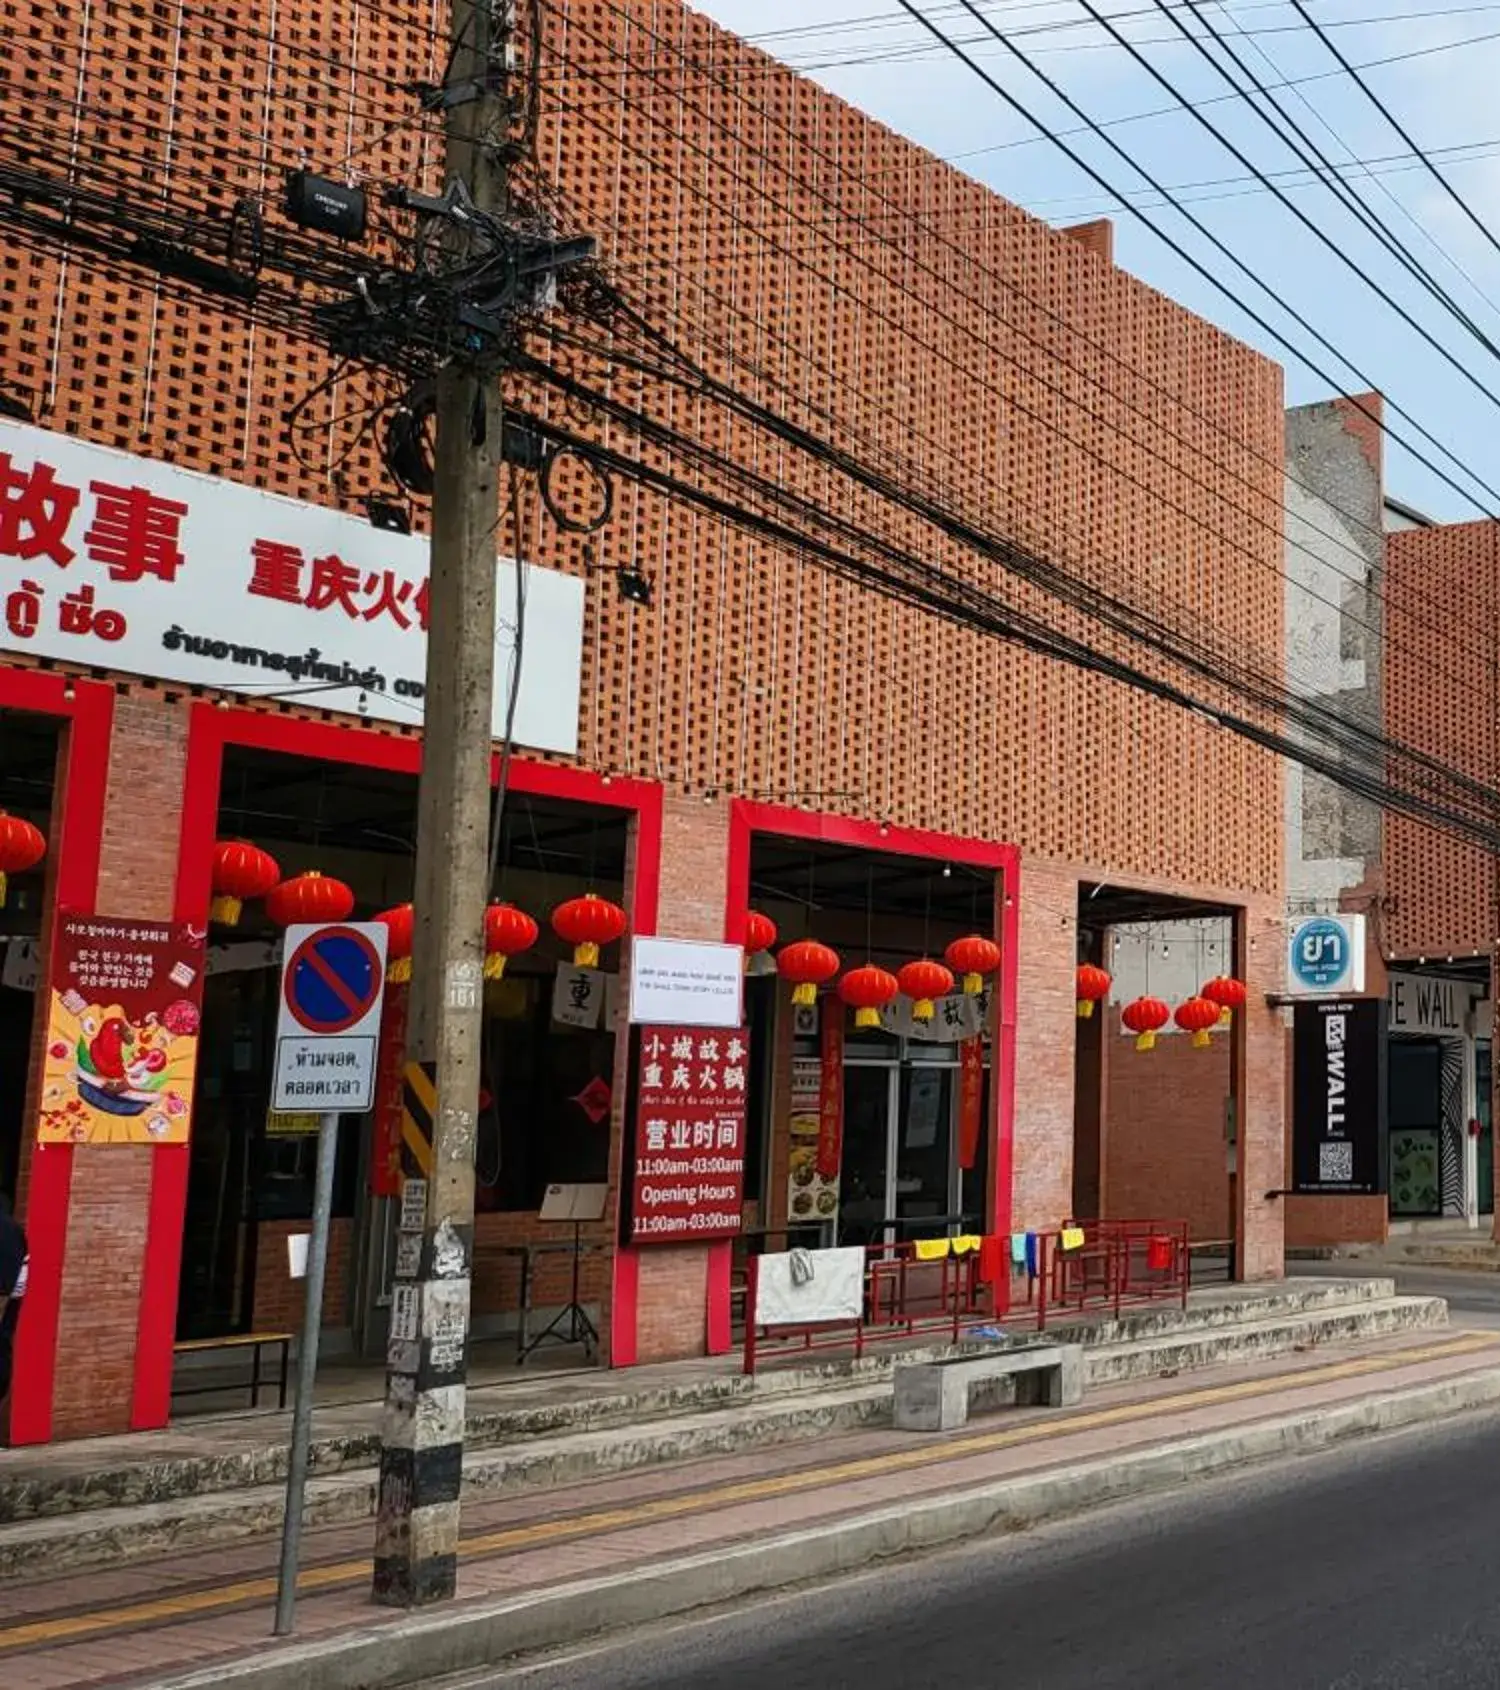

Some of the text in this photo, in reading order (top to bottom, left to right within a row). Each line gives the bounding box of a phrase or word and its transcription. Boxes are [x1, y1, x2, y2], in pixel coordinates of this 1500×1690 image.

[248, 539, 430, 632] 重庆火
[1303, 935, 1341, 963] ยา
[1416, 980, 1459, 1029] WALL
[295, 1047, 358, 1068] ห้ามจอด
[644, 1033, 747, 1063] 小城故事
[285, 1079, 361, 1096] ตลอดเวลา
[641, 1063, 746, 1091] 重庆火锅
[1327, 1050, 1345, 1131] WALL
[645, 1119, 739, 1150] 营业时间
[635, 1156, 744, 1176] 11:00am-03:00am
[641, 1183, 737, 1207] Opening Hours
[633, 1212, 742, 1234] 11:00am-03:00am
